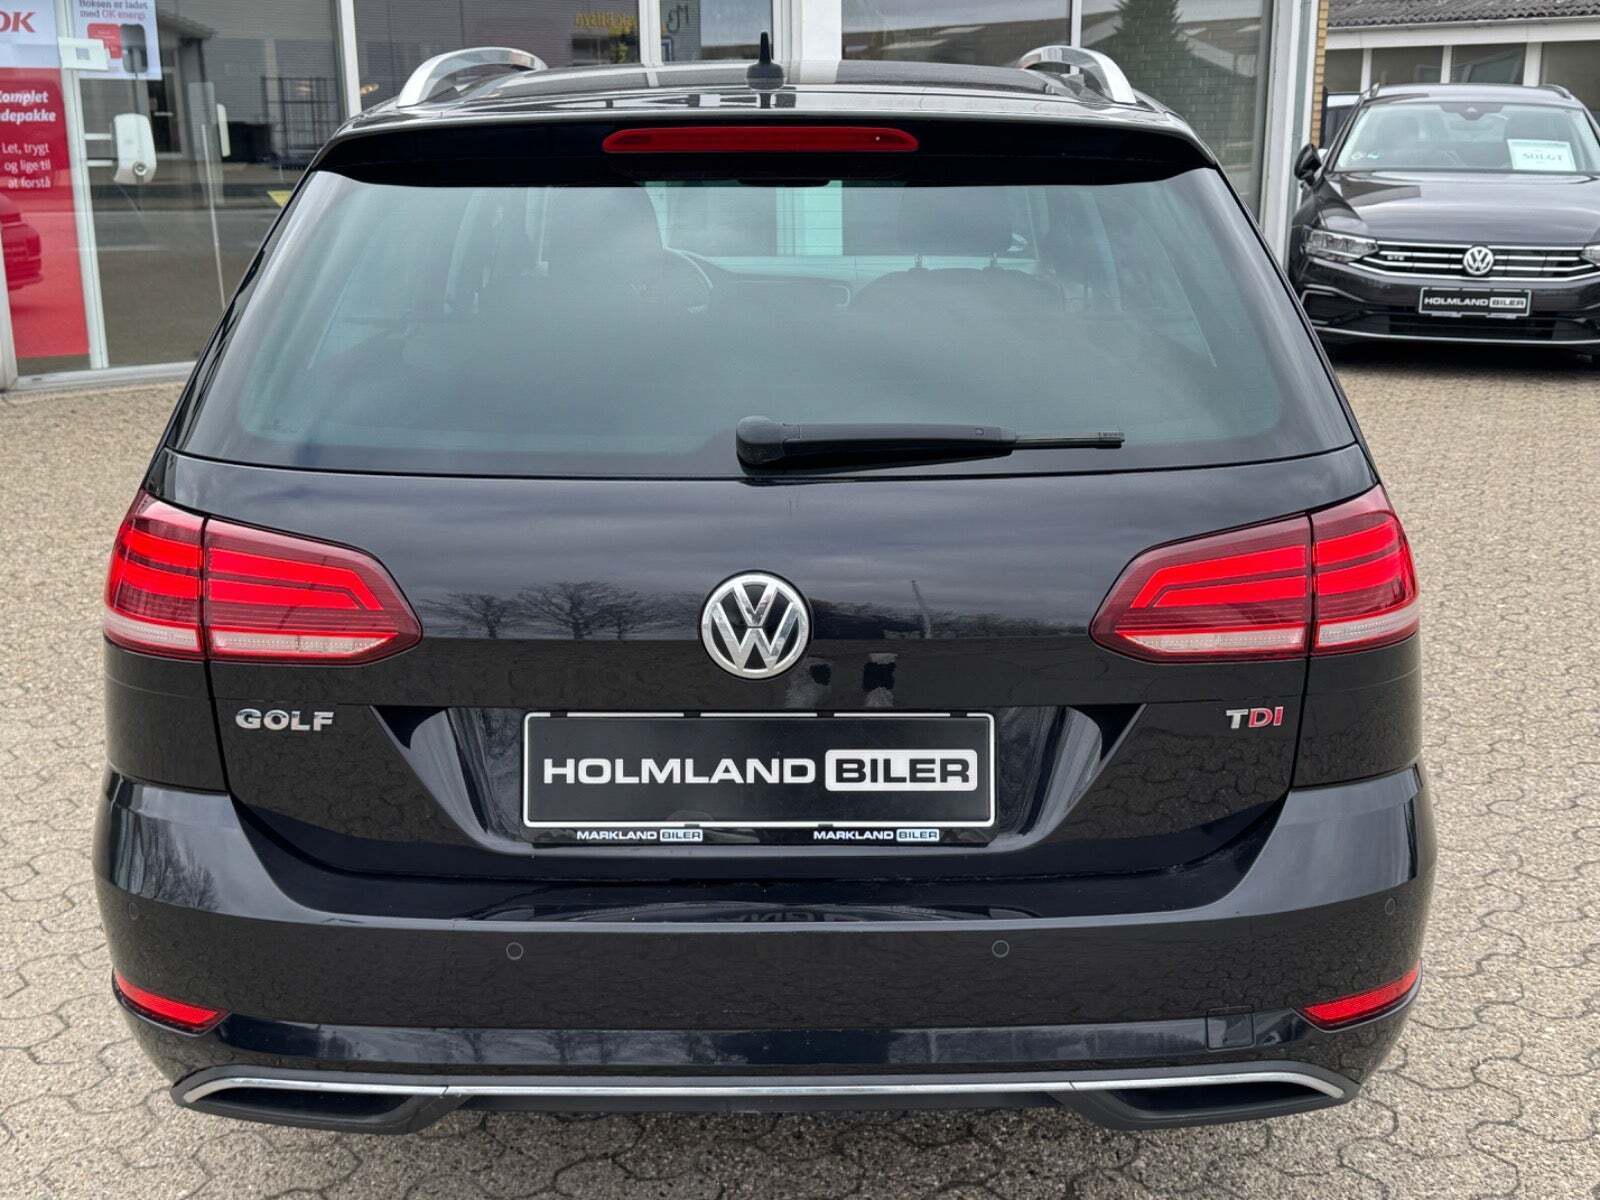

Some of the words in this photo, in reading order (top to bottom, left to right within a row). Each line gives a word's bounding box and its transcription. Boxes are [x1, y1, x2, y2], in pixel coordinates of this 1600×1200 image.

[80, 10, 99, 18] med
[2, 143, 21, 155] Let,
[23, 143, 49, 157] trygt
[4, 161, 18, 174] og
[20, 159, 39, 174] lige
[41, 159, 51, 171] til
[8, 177, 18, 189] at
[1424, 297, 1489, 307] HOLMLAND
[235, 708, 334, 731] GOLF
[1226, 706, 1284, 729] TDI
[543, 758, 817, 784] HOLMLAND
[834, 757, 970, 784] BILER
[576, 830, 658, 840] MARKLAND
[661, 830, 702, 840] BILER
[813, 830, 894, 840] MARKLAND
[898, 830, 938, 840] BILER
